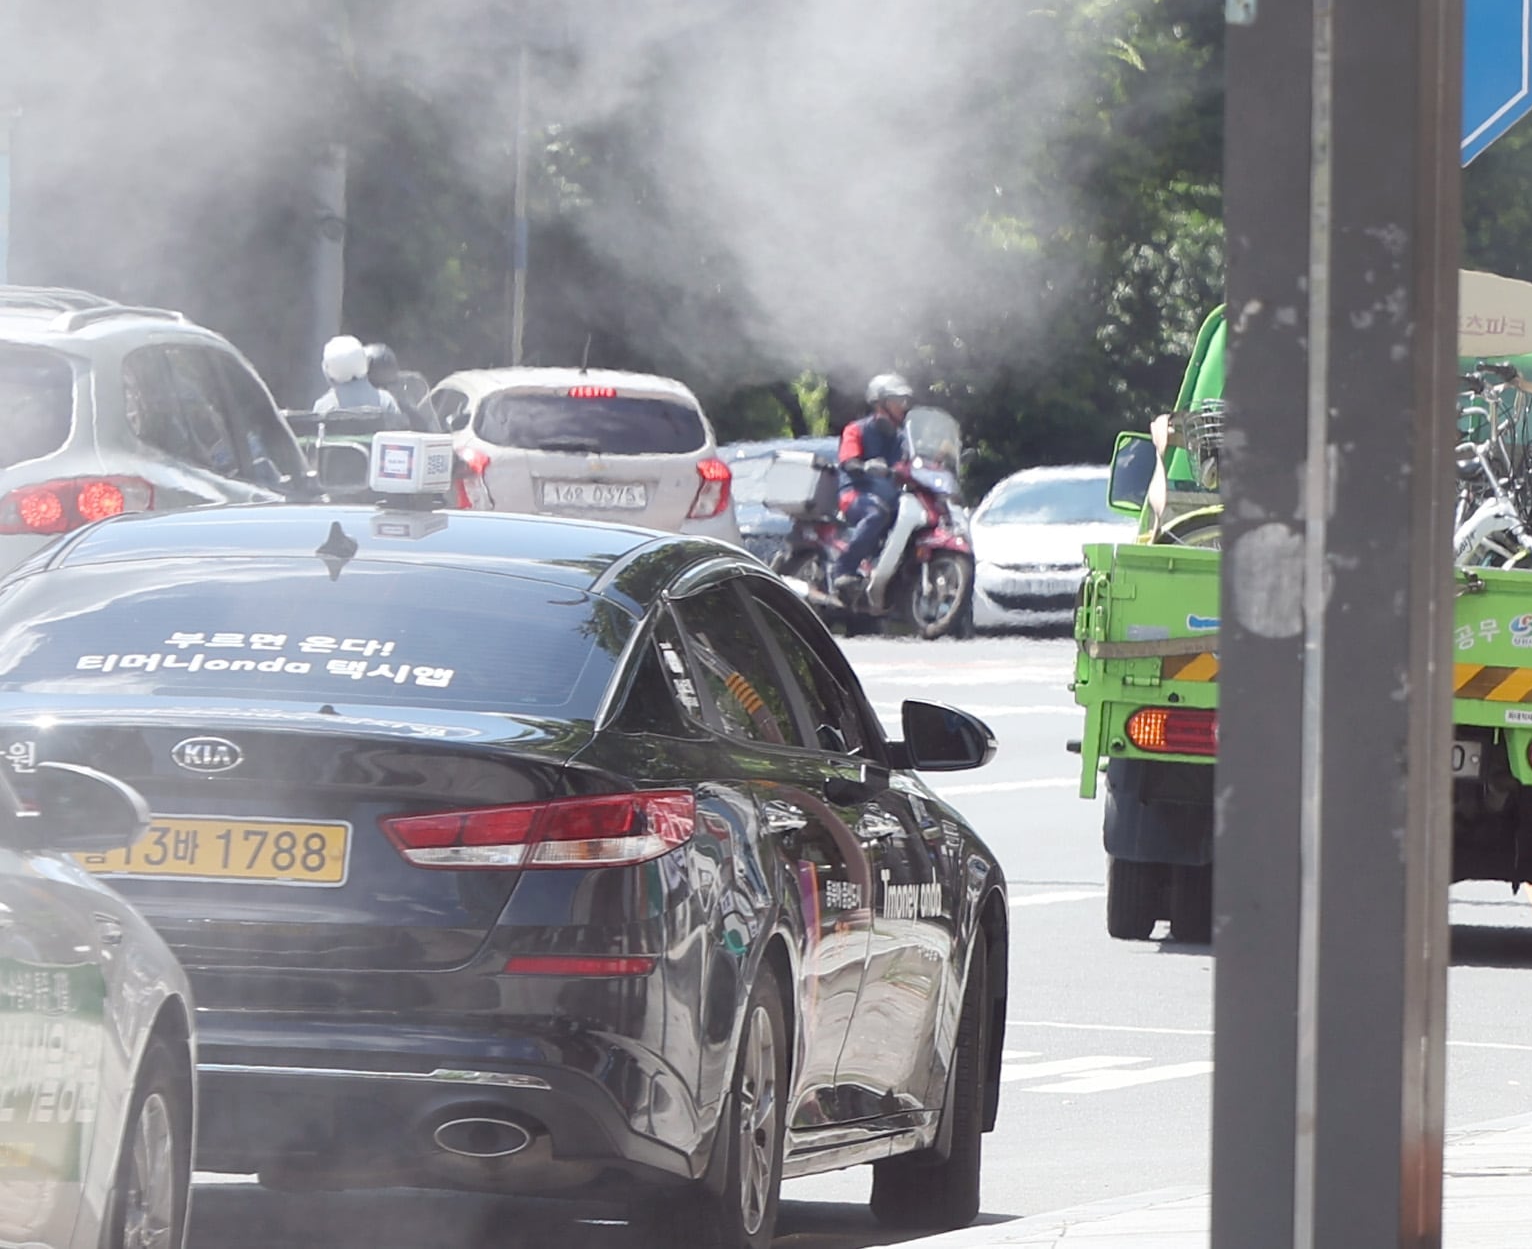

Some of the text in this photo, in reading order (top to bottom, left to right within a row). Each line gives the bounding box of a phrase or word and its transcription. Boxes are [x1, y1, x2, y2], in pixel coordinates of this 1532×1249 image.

[164, 631, 396, 658] 부르면 온다!
[1454, 618, 1502, 650] 공무
[75, 653, 455, 688] 티머니onda 택시앱
[182, 743, 233, 766] KIA
[215, 829, 328, 873] 1788
